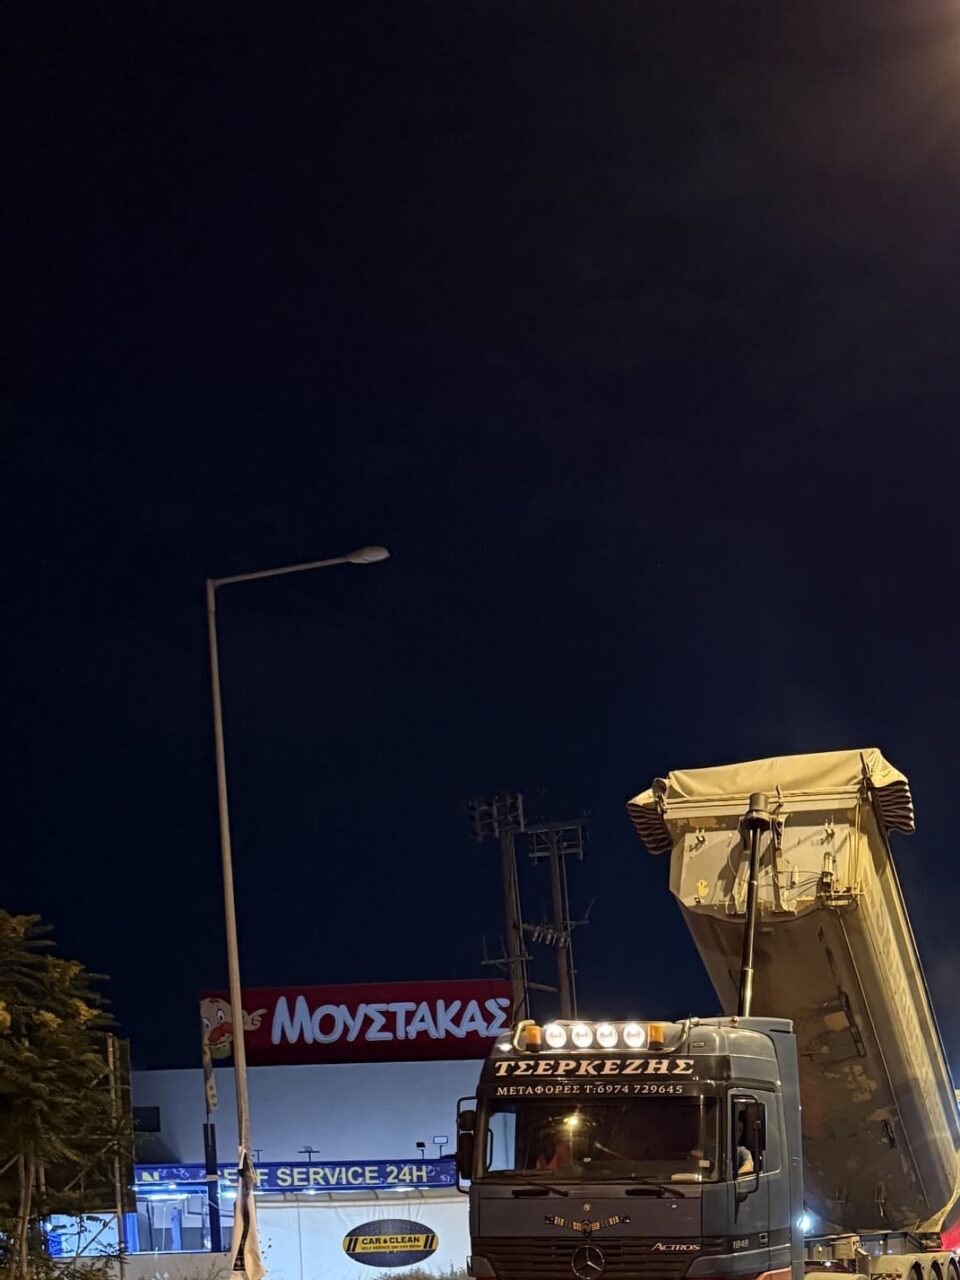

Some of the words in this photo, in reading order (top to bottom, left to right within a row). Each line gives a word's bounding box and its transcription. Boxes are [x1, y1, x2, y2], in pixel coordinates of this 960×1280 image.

[494, 1058, 695, 1077] ΤΣΕΡΚΕΖΗΣ
[496, 1084, 580, 1097] ΜΕΤΑΦΟΡΕΣ
[633, 1084, 684, 1095] 729645
[276, 1166, 379, 1187] SERVICE
[385, 1165, 428, 1184] 24H
[389, 1236, 420, 1244] CLEAN
